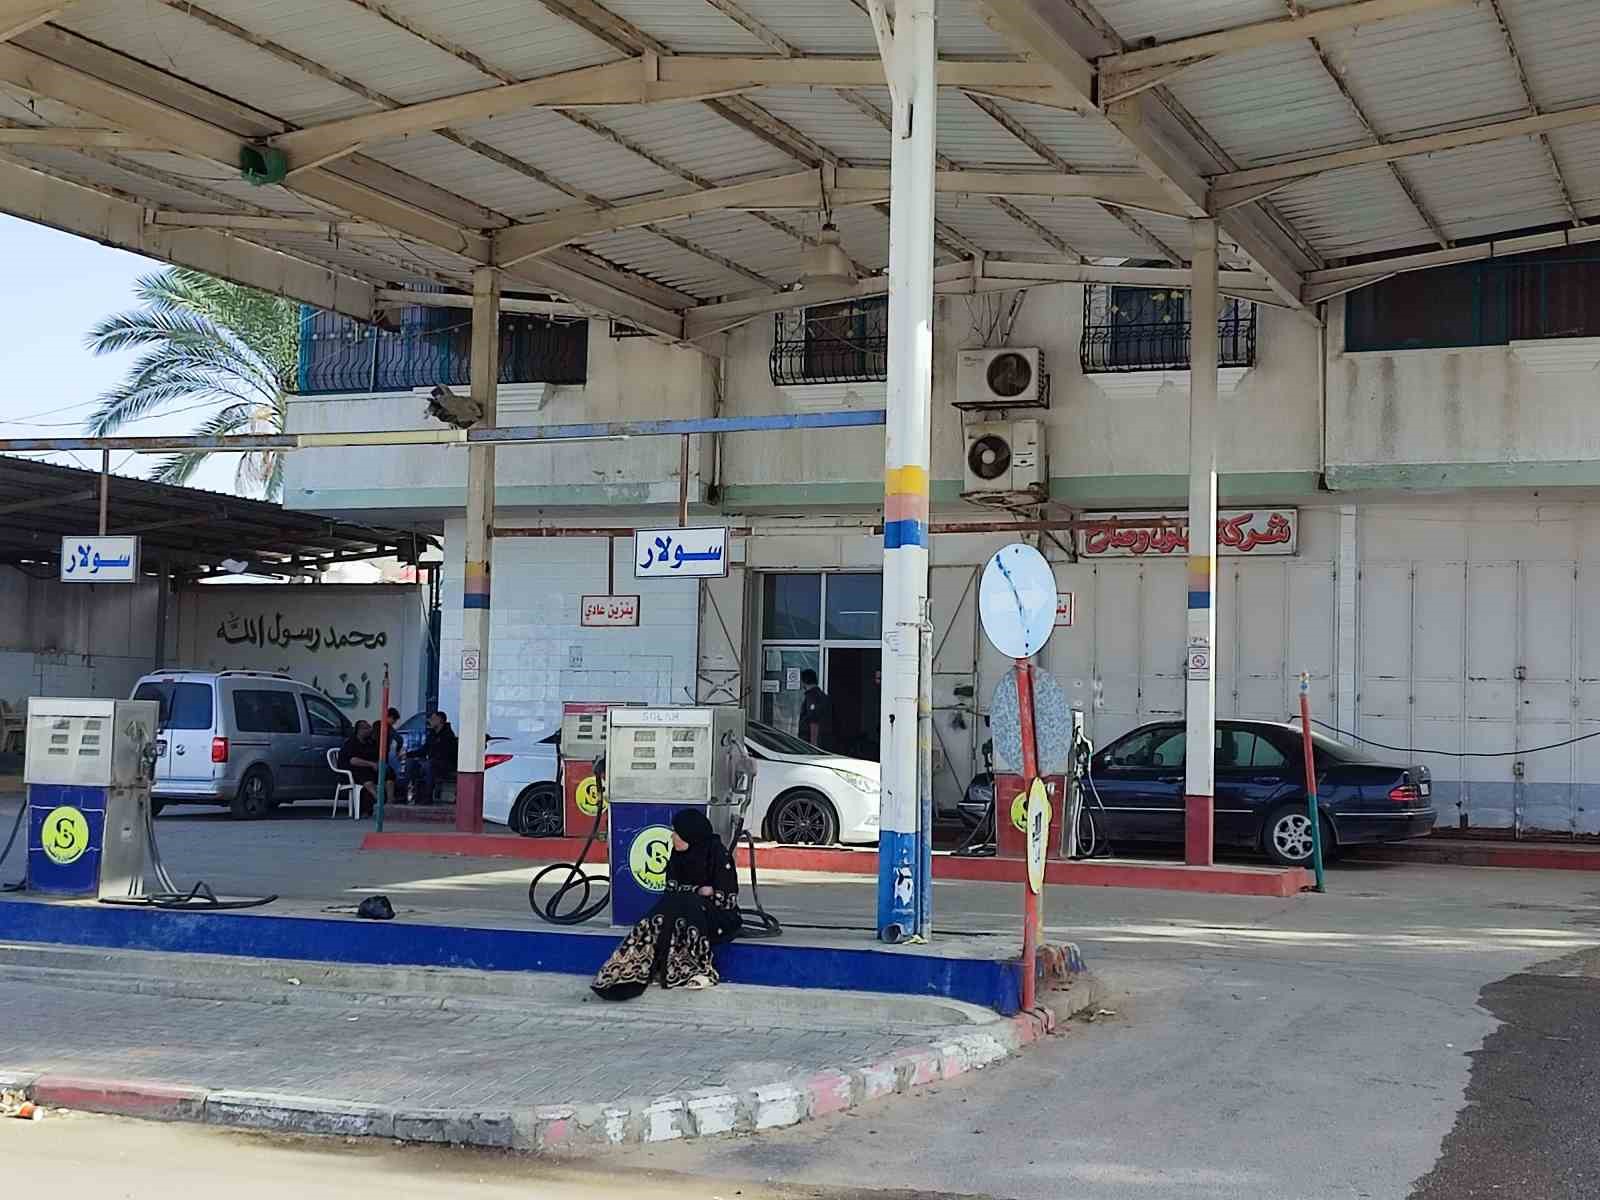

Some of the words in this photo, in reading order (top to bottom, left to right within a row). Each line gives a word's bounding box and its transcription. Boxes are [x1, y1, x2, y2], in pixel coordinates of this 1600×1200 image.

[65, 543, 131, 573] سولار
[640, 535, 722, 568] سولار
[608, 601, 634, 620] بنزين
[267, 612, 321, 651] رسول
[323, 625, 388, 650] محمد
